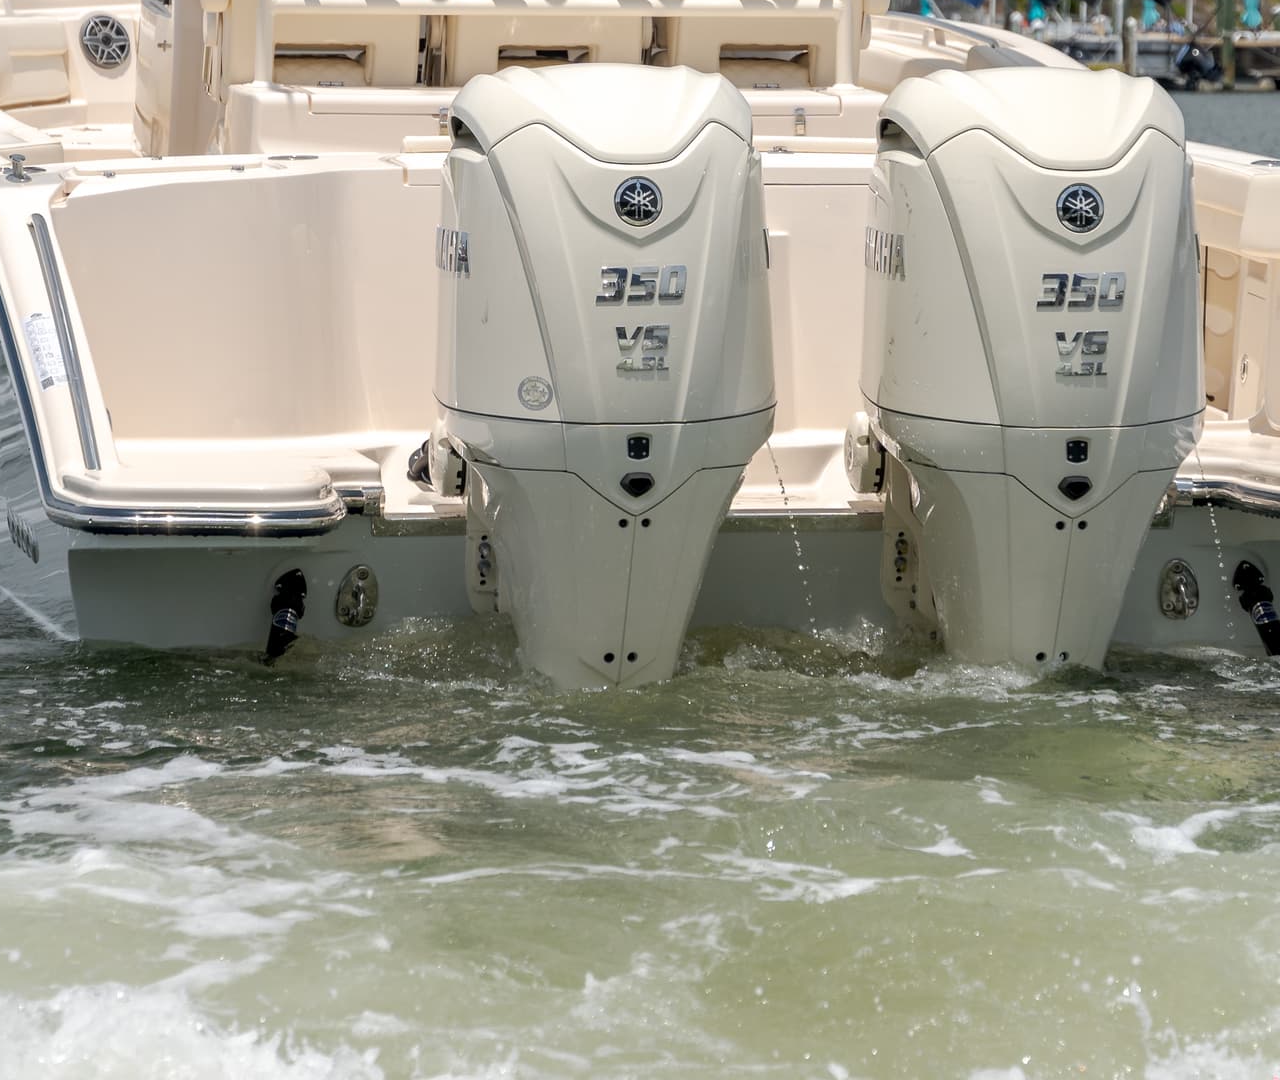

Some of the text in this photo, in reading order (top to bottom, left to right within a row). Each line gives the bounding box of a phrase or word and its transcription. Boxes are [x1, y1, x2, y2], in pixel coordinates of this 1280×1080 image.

[596, 265, 687, 304] 350
[1037, 272, 1126, 310] 350
[1055, 331, 1109, 356] V6
